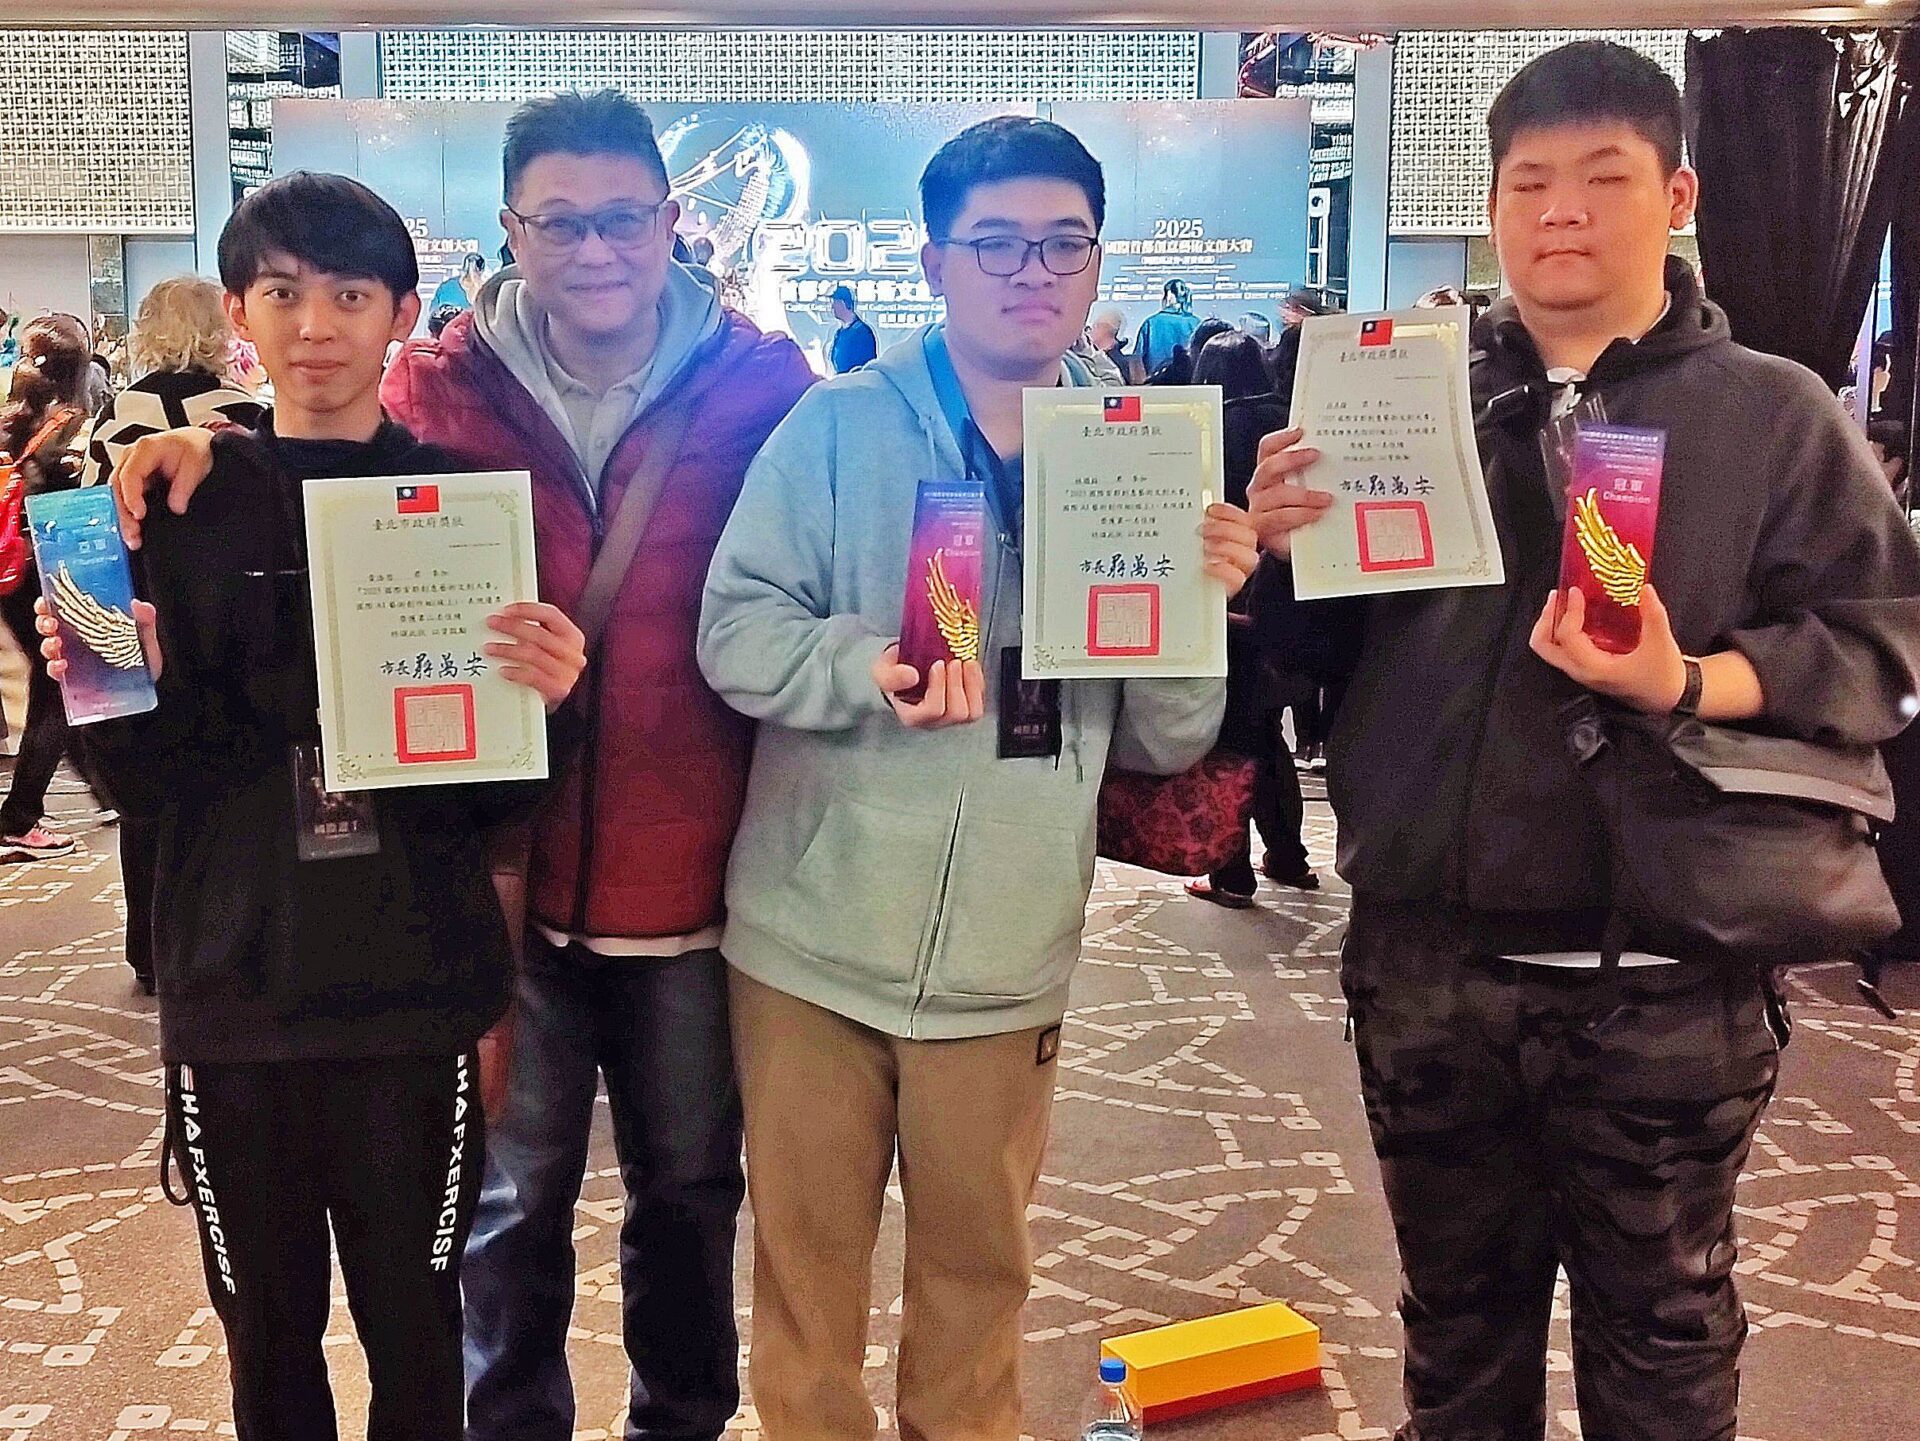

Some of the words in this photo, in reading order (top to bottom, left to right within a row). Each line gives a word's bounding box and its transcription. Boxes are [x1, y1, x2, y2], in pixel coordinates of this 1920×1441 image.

[404, 217, 428, 238] 25
[1153, 219, 1204, 239] 2025
[756, 219, 919, 276] 202
